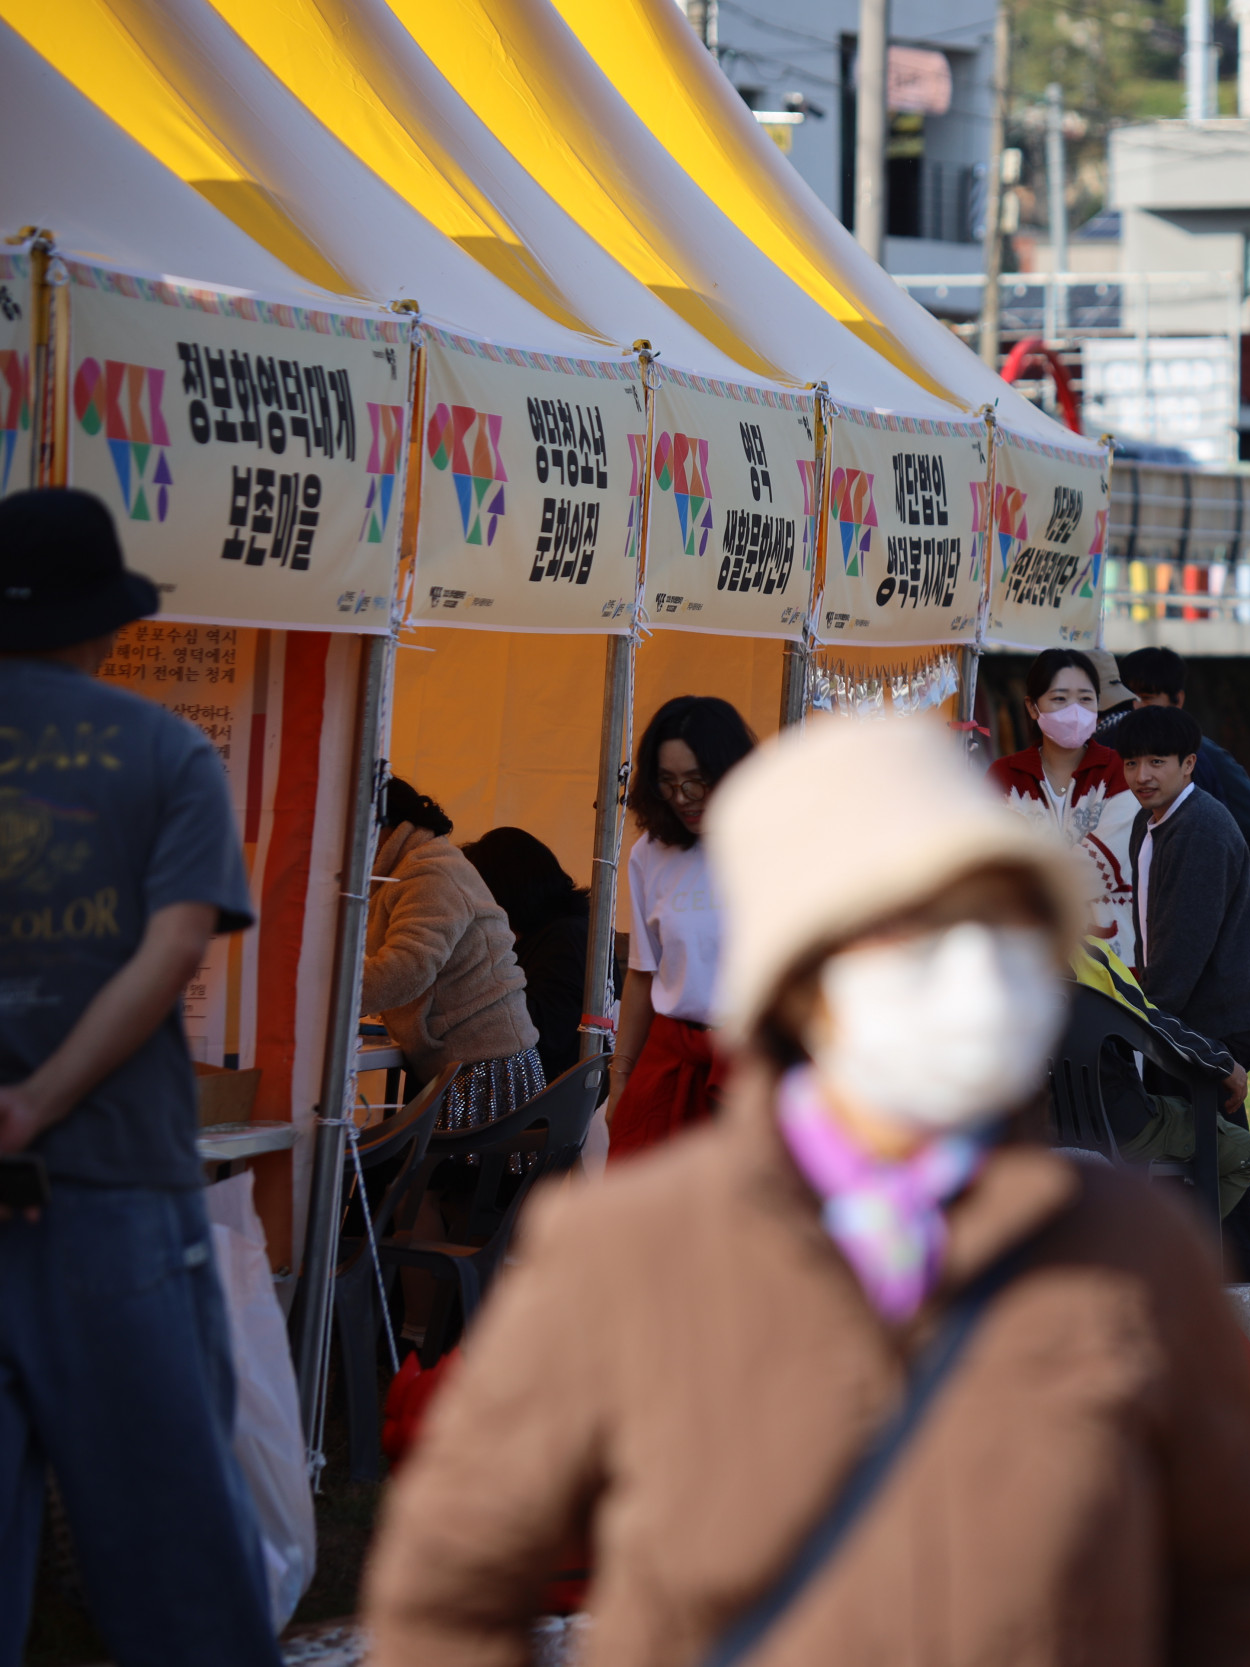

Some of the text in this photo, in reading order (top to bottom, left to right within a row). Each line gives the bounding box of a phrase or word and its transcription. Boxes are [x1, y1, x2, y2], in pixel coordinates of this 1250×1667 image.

[527, 396, 608, 489] 영덕청소년
[739, 421, 773, 503] 영덕
[221, 465, 322, 571] 보존마을
[893, 452, 949, 526] 재단법인
[1046, 485, 1084, 544] 재단법인
[716, 508, 796, 595] 생활문화센터
[876, 535, 961, 609] 영덕복지재단
[136, 625, 199, 645] 분포수심
[205, 628, 237, 646] 역시
[173, 646, 237, 665] 영덕에선
[152, 664, 201, 682] 전에는
